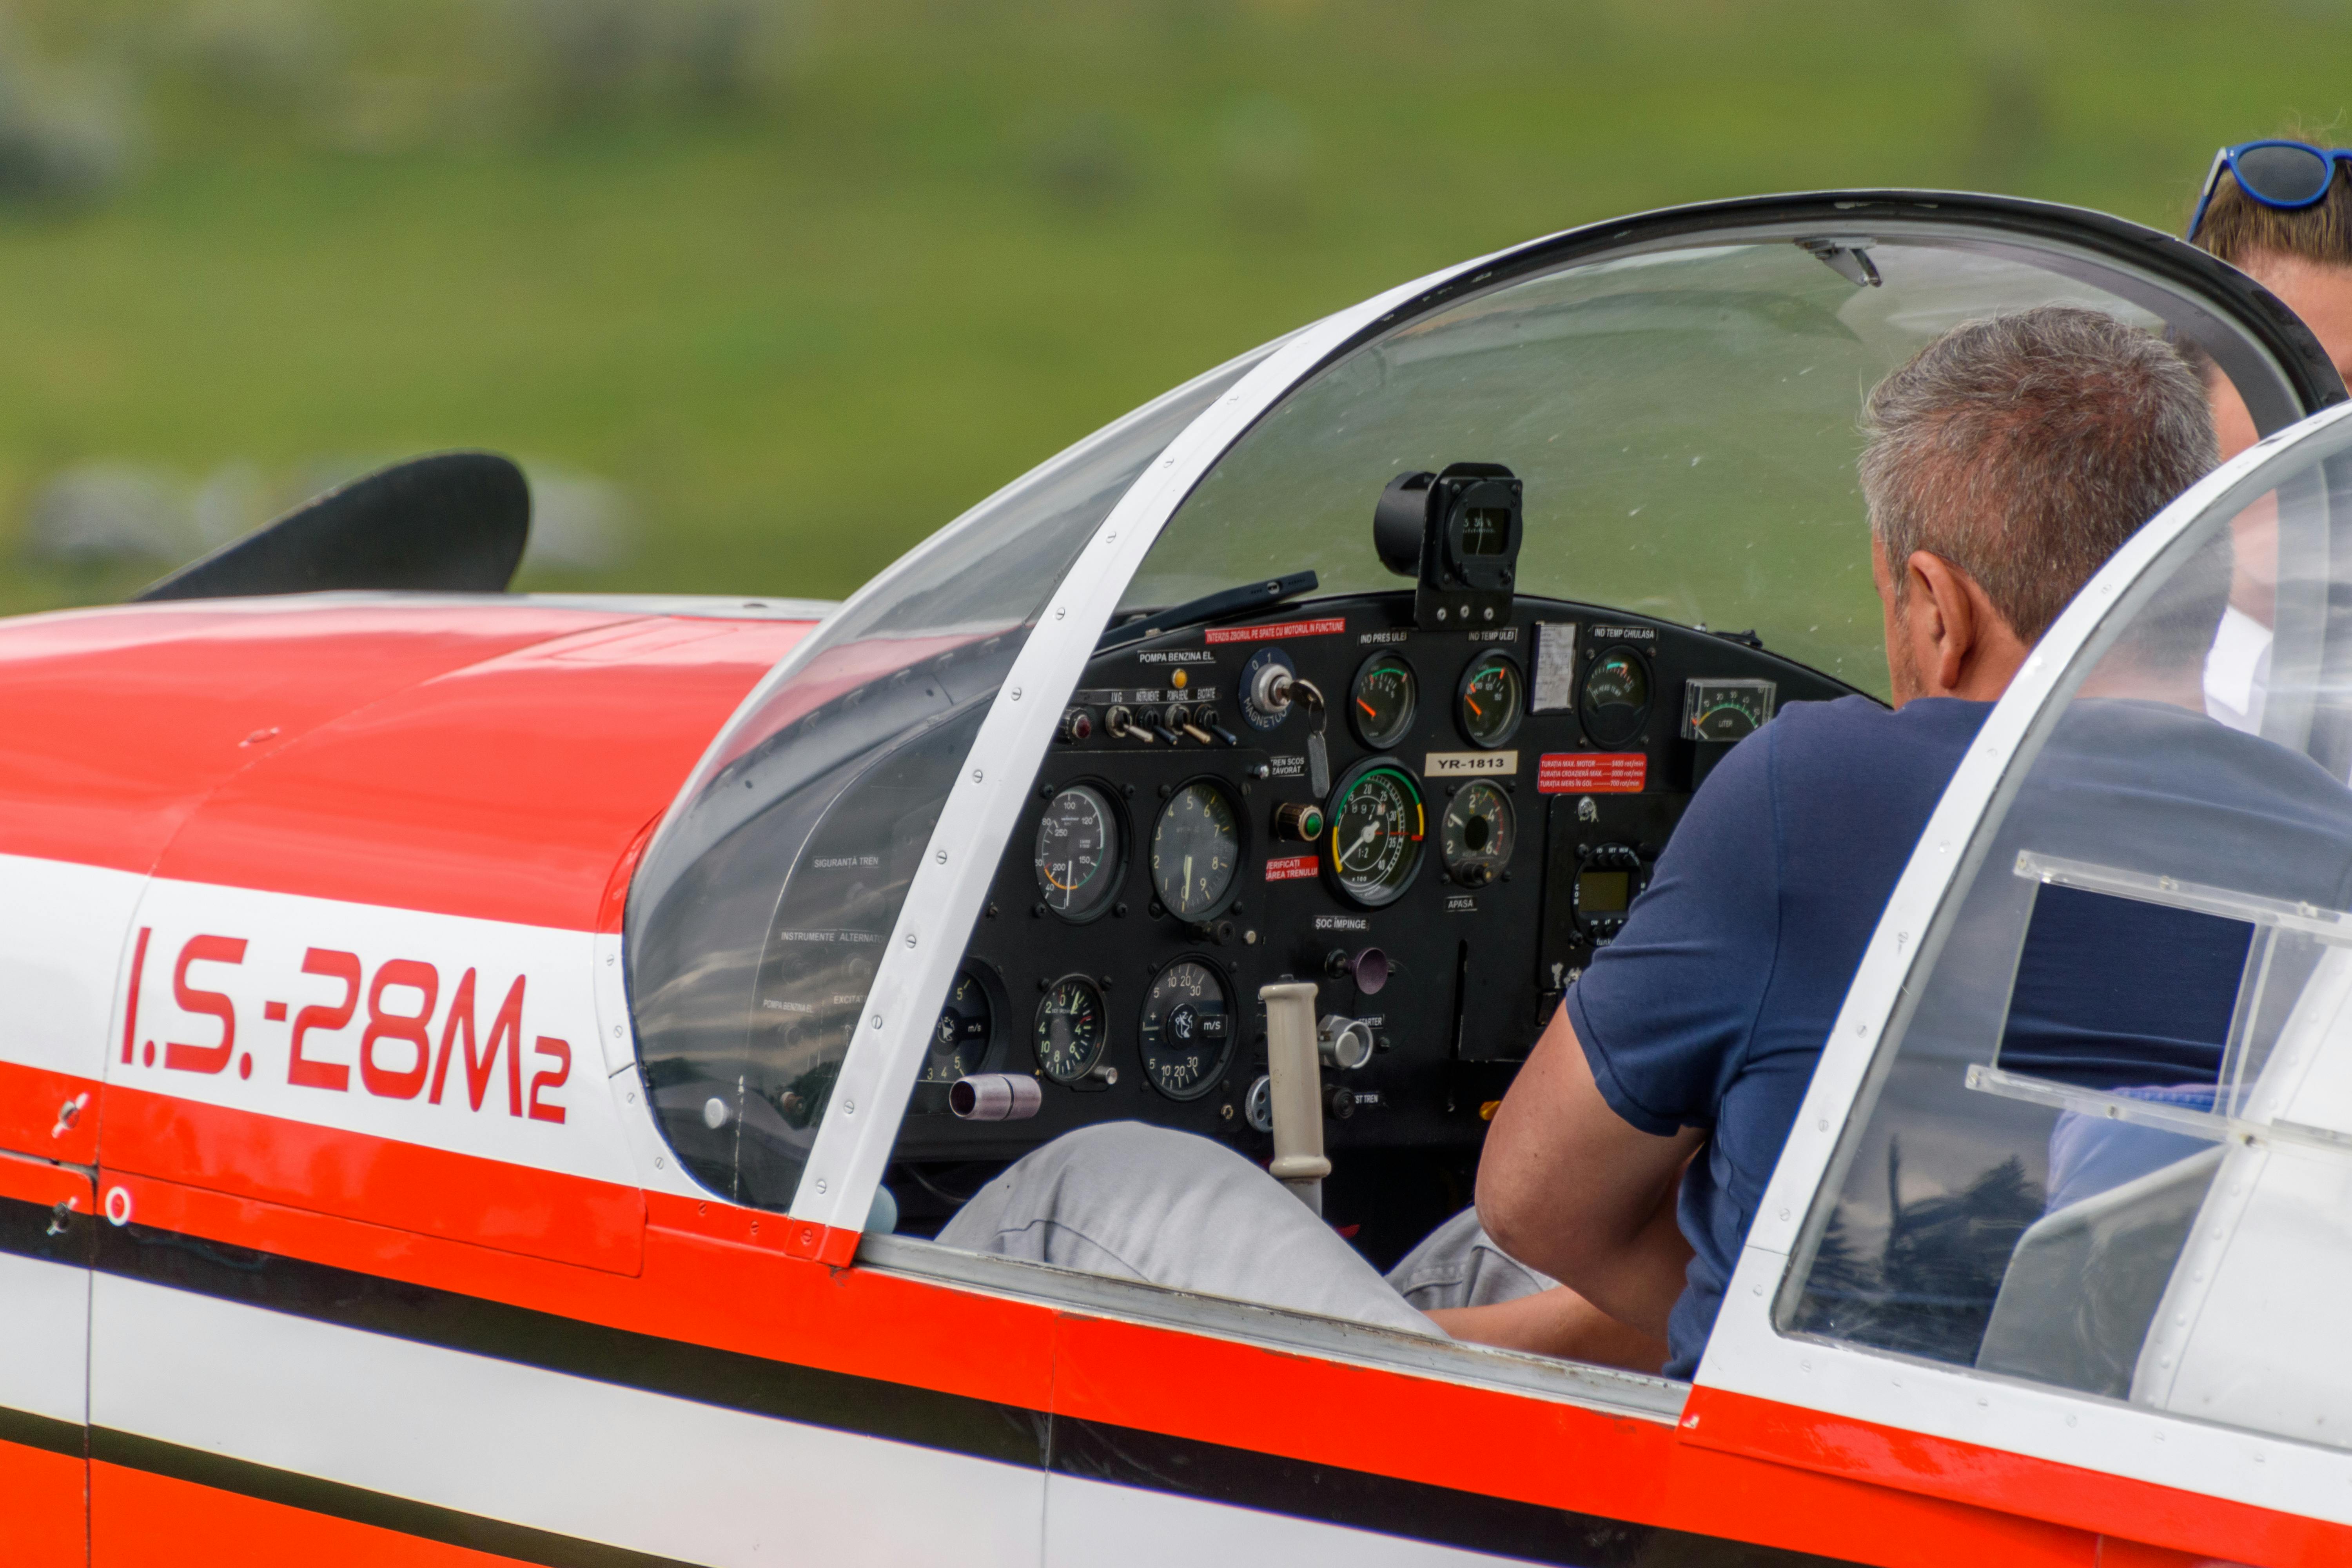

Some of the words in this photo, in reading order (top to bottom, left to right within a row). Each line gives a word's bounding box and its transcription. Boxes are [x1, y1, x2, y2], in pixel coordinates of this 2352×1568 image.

[1207, 632, 1229, 642] INTERZIS
[1230, 630, 1250, 640] ZBORUL
[1251, 629, 1258, 639] PE
[1259, 628, 1274, 637] SPATE
[1276, 627, 1283, 636] CU
[1284, 624, 1308, 635] MOTORUL
[1309, 624, 1314, 632] IN
[1315, 621, 1343, 632] FUNCTIUNE
[1468, 632, 1480, 641] IND
[1481, 632, 1497, 641] TEMP
[1499, 632, 1515, 641] ULEI
[1595, 628, 1605, 637] IND
[1607, 629, 1622, 638] TEMP
[1624, 629, 1654, 639] CHIULASA
[1361, 633, 1372, 644] IND
[1373, 633, 1390, 643] PRES
[1392, 632, 1407, 641] ULEI
[1140, 653, 1166, 662] POMPA
[1169, 652, 1201, 661] BENZINA
[1203, 651, 1214, 660] EL.
[1267, 653, 1271, 663] 1
[1252, 661, 1258, 670] 0
[1136, 691, 1159, 701] INSTRUMENTE
[1167, 690, 1178, 701] POMPA
[1438, 759, 1504, 769] YR-1813
[1364, 784, 1371, 794] 20
[1380, 791, 1387, 802] 25
[1469, 794, 1475, 808] 2
[1187, 796, 1193, 810] 5
[1168, 804, 1174, 817] 4
[1204, 804, 1210, 817] 6
[1389, 811, 1396, 821] 30
[1488, 808, 1494, 821] 4
[1155, 826, 1161, 840] 3
[1214, 824, 1220, 838] 7
[1389, 838, 1396, 848] 35
[1446, 840, 1454, 854] 2
[1486, 841, 1493, 855] 6
[1358, 848, 1368, 858] 1:2
[859, 857, 878, 865] TREN
[1154, 855, 1160, 869] 2
[1212, 856, 1218, 870] 8
[1378, 860, 1385, 870] 40
[1287, 867, 1318, 877] TRENULUI
[1165, 878, 1168, 891] 1
[1200, 878, 1207, 891] 9
[781, 932, 834, 941] INSTRUMENTE
[1168, 977, 1176, 987] 10
[1180, 976, 1191, 987] 20
[957, 988, 963, 1000] 5
[1154, 988, 1160, 998] 5
[1190, 985, 1201, 996] 30
[763, 999, 782, 1009] POMPA
[782, 1002, 806, 1012] BENZINA
[1060, 995, 1066, 1007] 0
[1045, 1001, 1052, 1014] 2
[968, 1023, 982, 1033] m/s
[1039, 1022, 1046, 1034] 4
[1075, 1024, 1082, 1035] 4
[1041, 1040, 1050, 1053] 10
[1069, 1041, 1076, 1053] 6
[1054, 1050, 1060, 1063] 8
[954, 1056, 960, 1069] 5
[1149, 1058, 1155, 1069] 5
[1187, 1057, 1198, 1068] 30
[927, 1067, 933, 1080] 3
[941, 1066, 947, 1078] 4
[1161, 1065, 1171, 1076] 10
[1174, 1066, 1185, 1077] 20
[1354, 1094, 1363, 1104] ST
[1364, 1094, 1379, 1103] TREN
